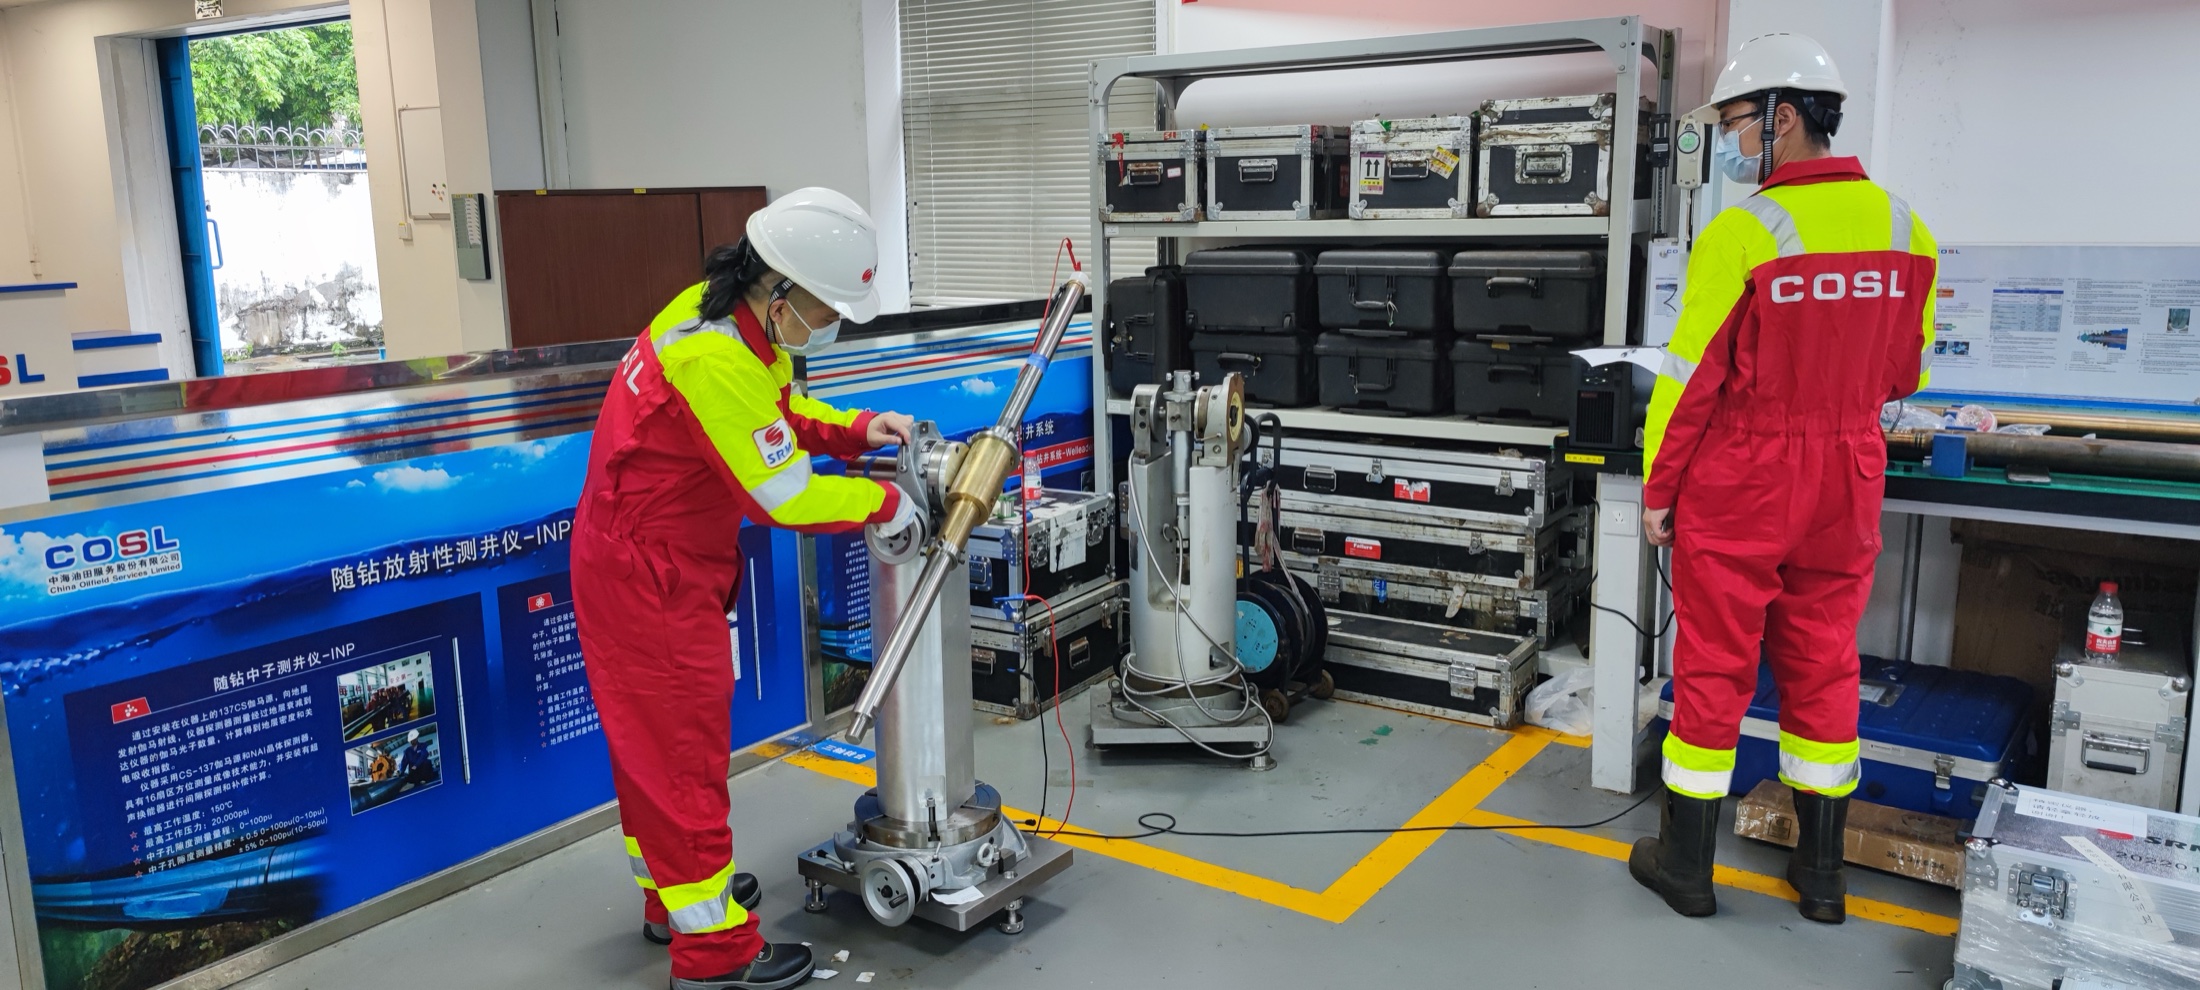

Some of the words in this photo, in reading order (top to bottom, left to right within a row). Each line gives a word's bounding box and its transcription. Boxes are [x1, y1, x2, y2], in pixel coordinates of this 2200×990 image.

[1771, 270, 1905, 303] COSL
[767, 441, 793, 465] SRM
[45, 528, 178, 570] COSL
[331, 519, 575, 592] 随钻放射性测井仪-INP
[48, 552, 180, 585] 中海油田服务股份有限公司
[50, 582, 77, 595] China
[79, 576, 110, 588] Oilfield
[112, 570, 148, 582] Services
[150, 562, 181, 575] Limited
[213, 643, 355, 692] 随钻中子测井仪-INP
